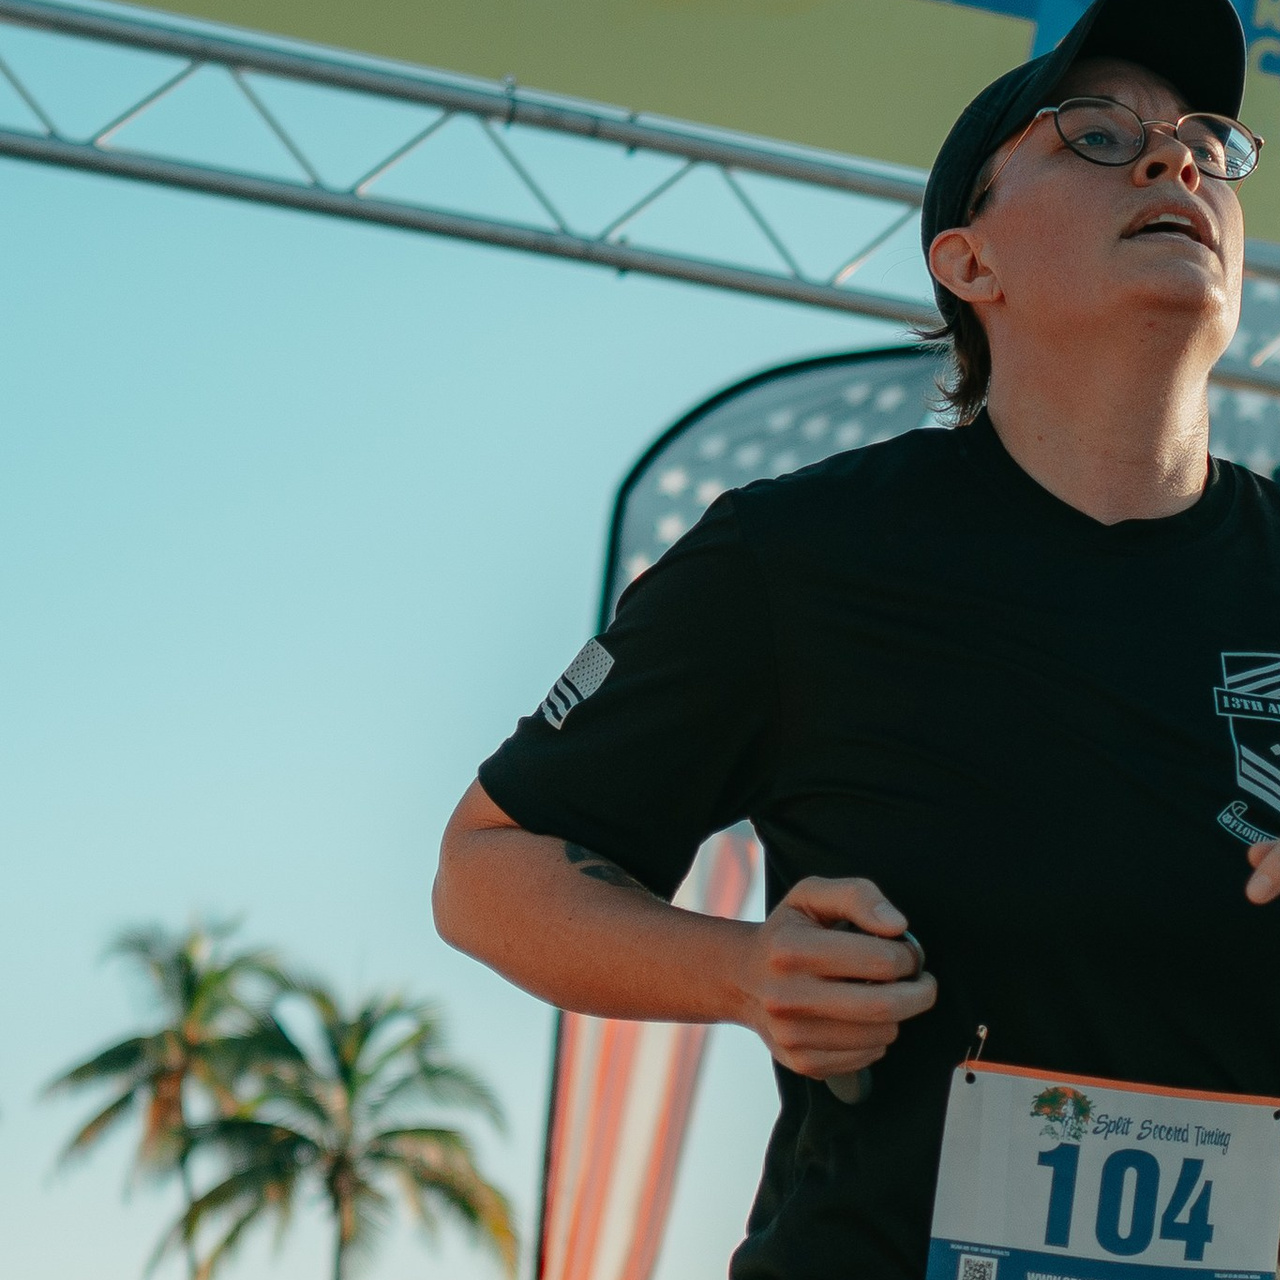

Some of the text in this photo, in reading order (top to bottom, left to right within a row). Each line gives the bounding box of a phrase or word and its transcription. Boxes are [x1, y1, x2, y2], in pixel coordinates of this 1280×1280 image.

[1223, 695, 1264, 712] 13TH
[1092, 1114, 1231, 1155] Split Second Timing
[1037, 1142, 1214, 1262] 104
